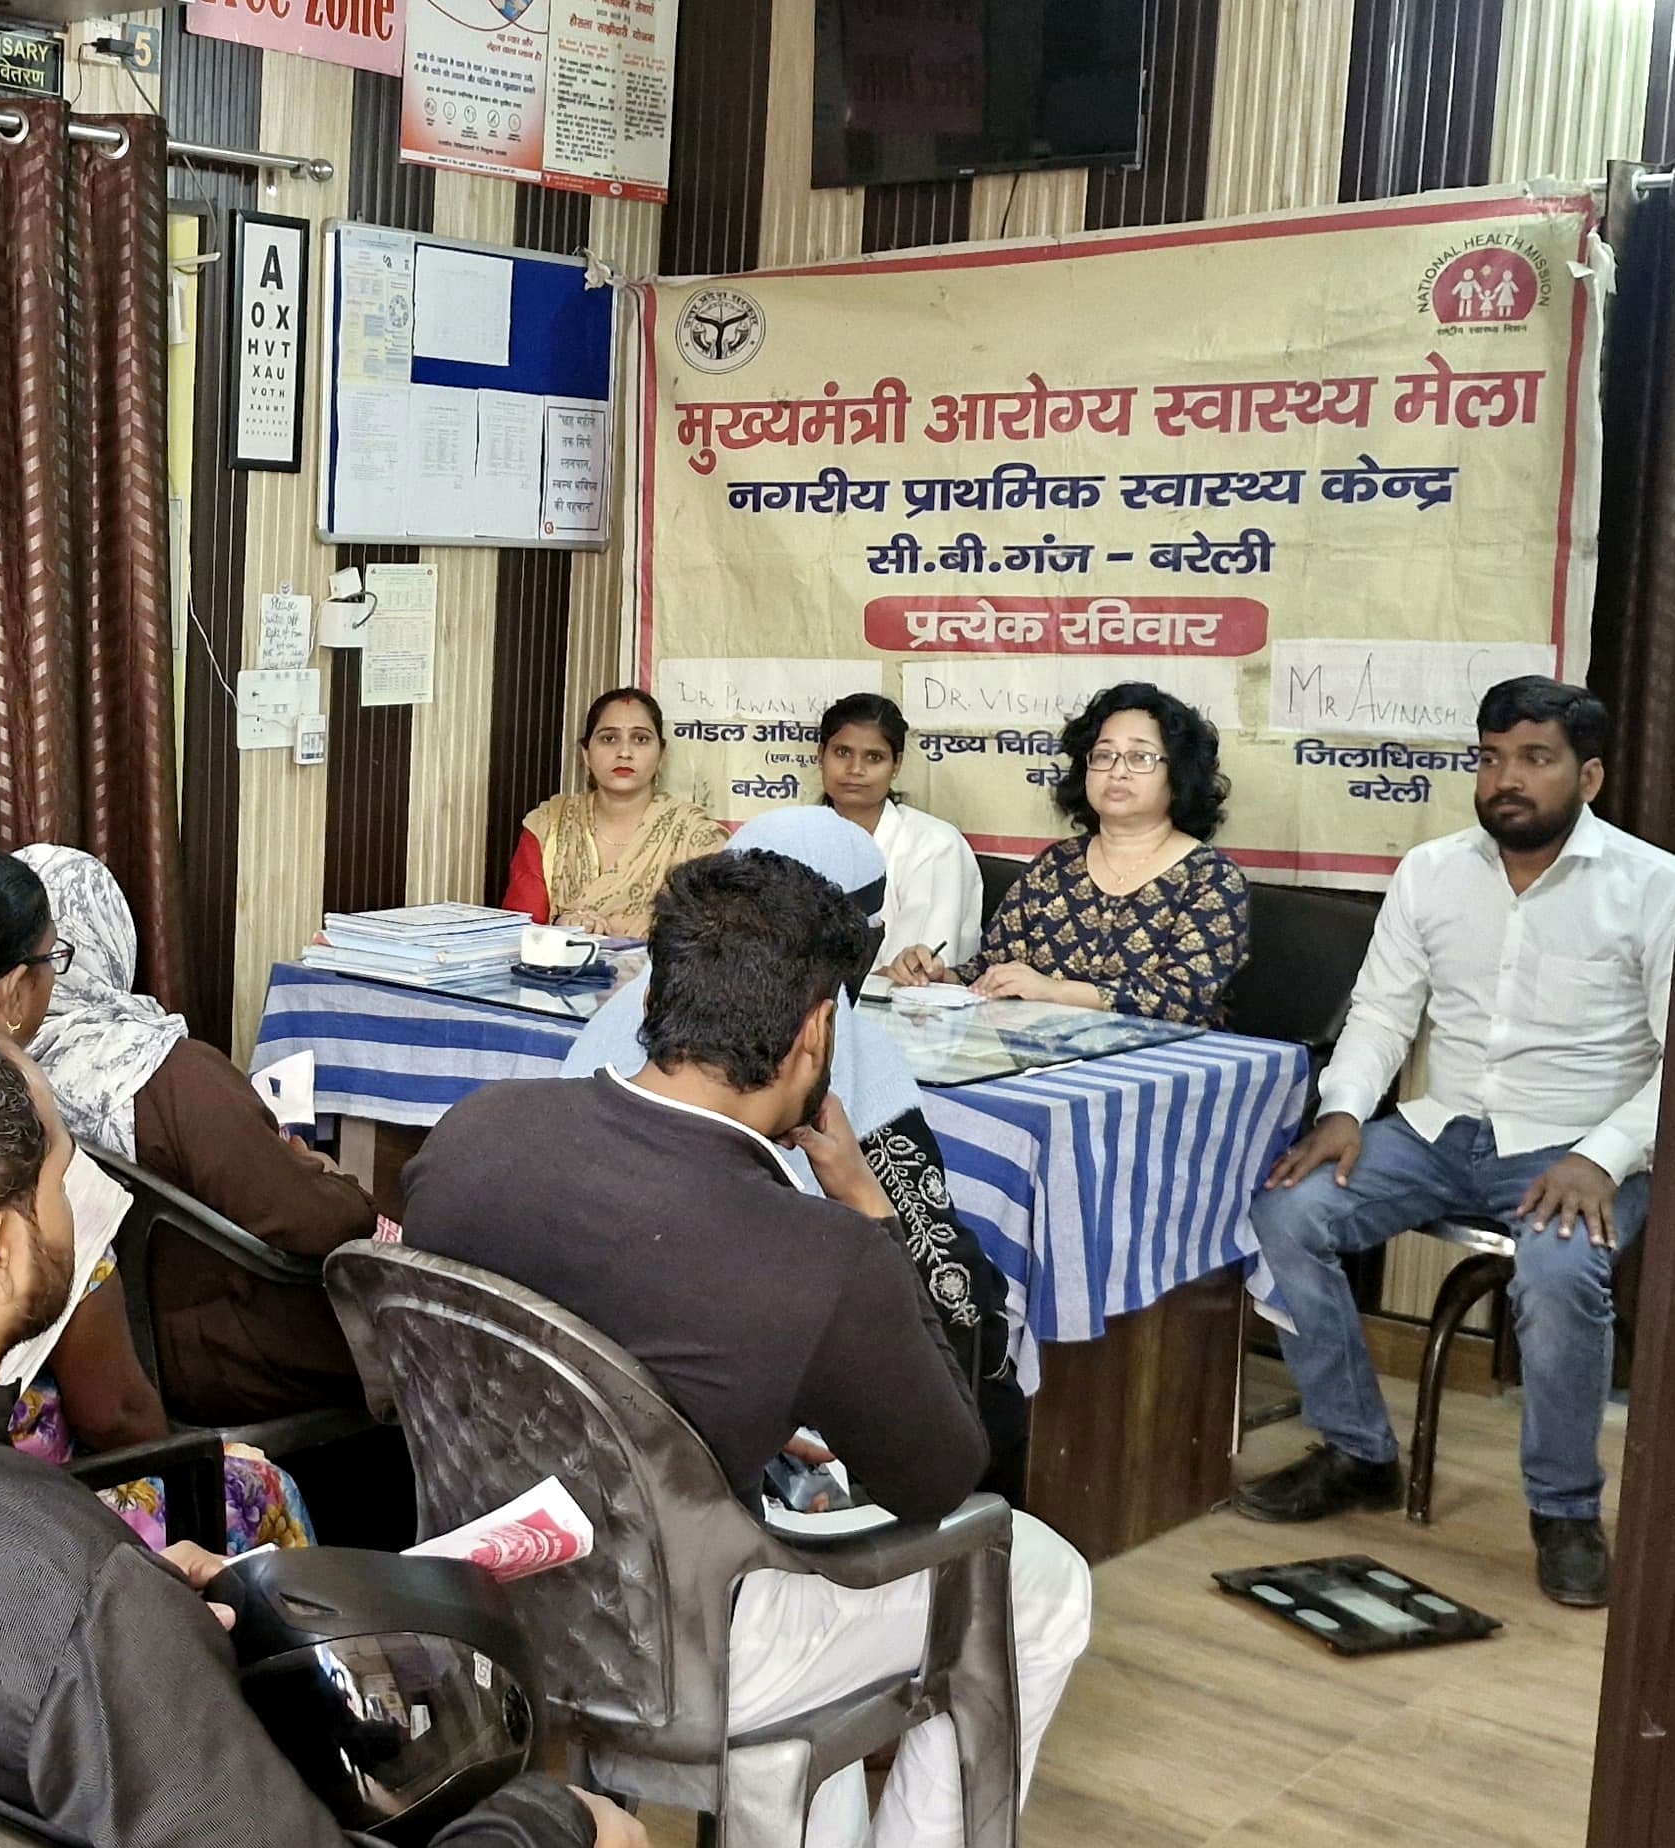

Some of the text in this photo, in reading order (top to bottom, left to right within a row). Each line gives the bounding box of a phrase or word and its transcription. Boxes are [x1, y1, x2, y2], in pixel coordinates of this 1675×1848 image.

[304, 0, 395, 41] zone
[134, 31, 152, 67] 5
[260, 245, 283, 290] A
[1417, 233, 1551, 314] NATIONAL HEALTH MISSION
[251, 301, 290, 330] O X
[248, 338, 291, 358] H V T
[676, 351, 1546, 474] मुख्यमंत्री आरोग्य स्वास्थ्य मेला
[727, 453, 1459, 518] नगरीय प्राथमिक स्वास्थ्य केन्द्र
[867, 533, 1094, 574] सी.बी.गंज
[1150, 528, 1275, 574] बरेली
[905, 599, 1222, 648] प्रत्येक रविवार
[980, 688, 1089, 716] VISHRA
[1348, 652, 1456, 726] AVINASH
[674, 720, 823, 743] नोडल अधिक
[919, 730, 1063, 761] मुख्य चिकि
[765, 750, 819, 768] (एन.यू.ए
[1025, 761, 1070, 786] बरे
[731, 774, 800, 799] बरेली
[1348, 775, 1432, 803] बरेली
